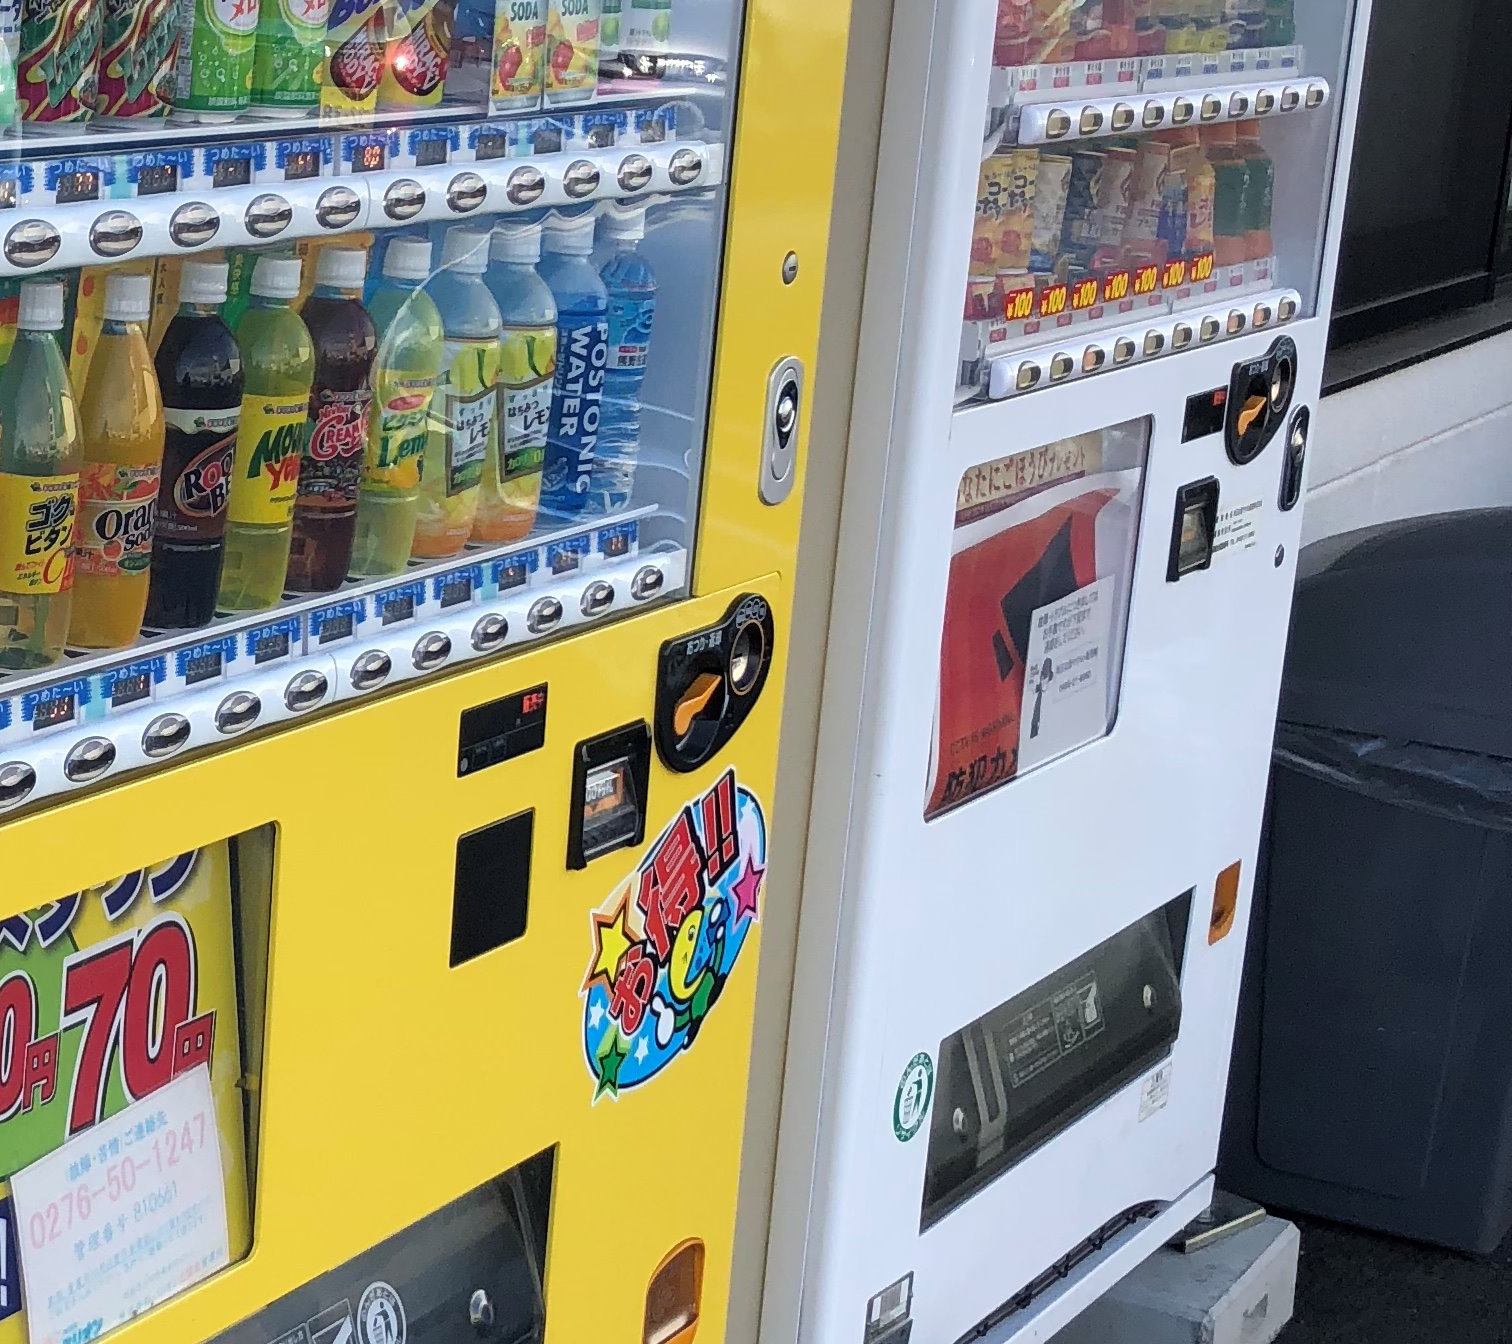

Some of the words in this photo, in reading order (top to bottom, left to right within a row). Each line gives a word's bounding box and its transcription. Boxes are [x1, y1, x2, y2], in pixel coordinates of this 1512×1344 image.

[510, 1, 539, 22] SODA
[1006, 291, 1034, 320] ¥100
[1040, 286, 1067, 316] ¥100
[1072, 281, 1098, 309] ¥100
[1104, 272, 1129, 301] ¥100
[1134, 267, 1158, 294] ¥100
[1162, 261, 1185, 289] ¥100
[1190, 255, 1213, 282] ¥100
[559, 325, 593, 436] WATER
[574, 321, 609, 494] POSTONIC
[62, 910, 217, 1143] 70円
[28, 1111, 207, 1252] 0276-50-1247
